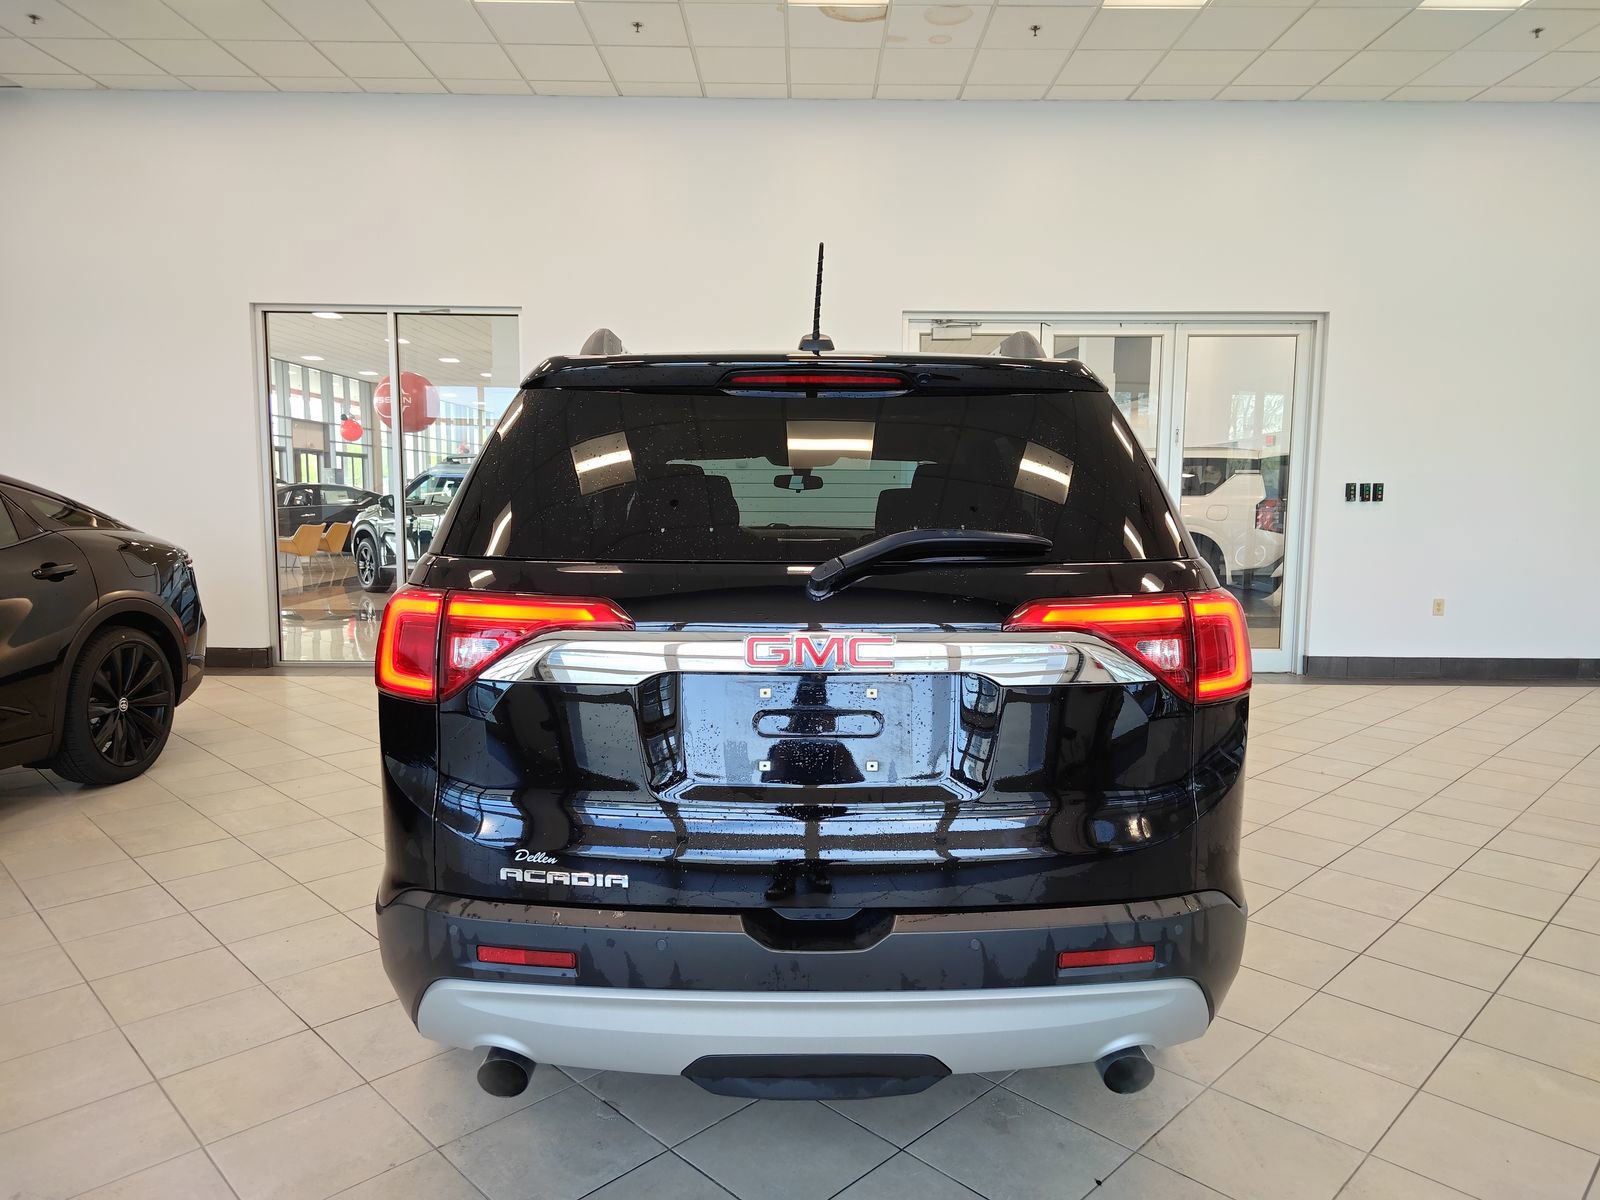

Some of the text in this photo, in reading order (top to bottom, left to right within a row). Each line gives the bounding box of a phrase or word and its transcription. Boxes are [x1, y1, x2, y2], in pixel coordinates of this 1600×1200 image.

[744, 634, 897, 669] GMC
[514, 849, 558, 865] Dellen
[500, 867, 629, 888] ACADIA
